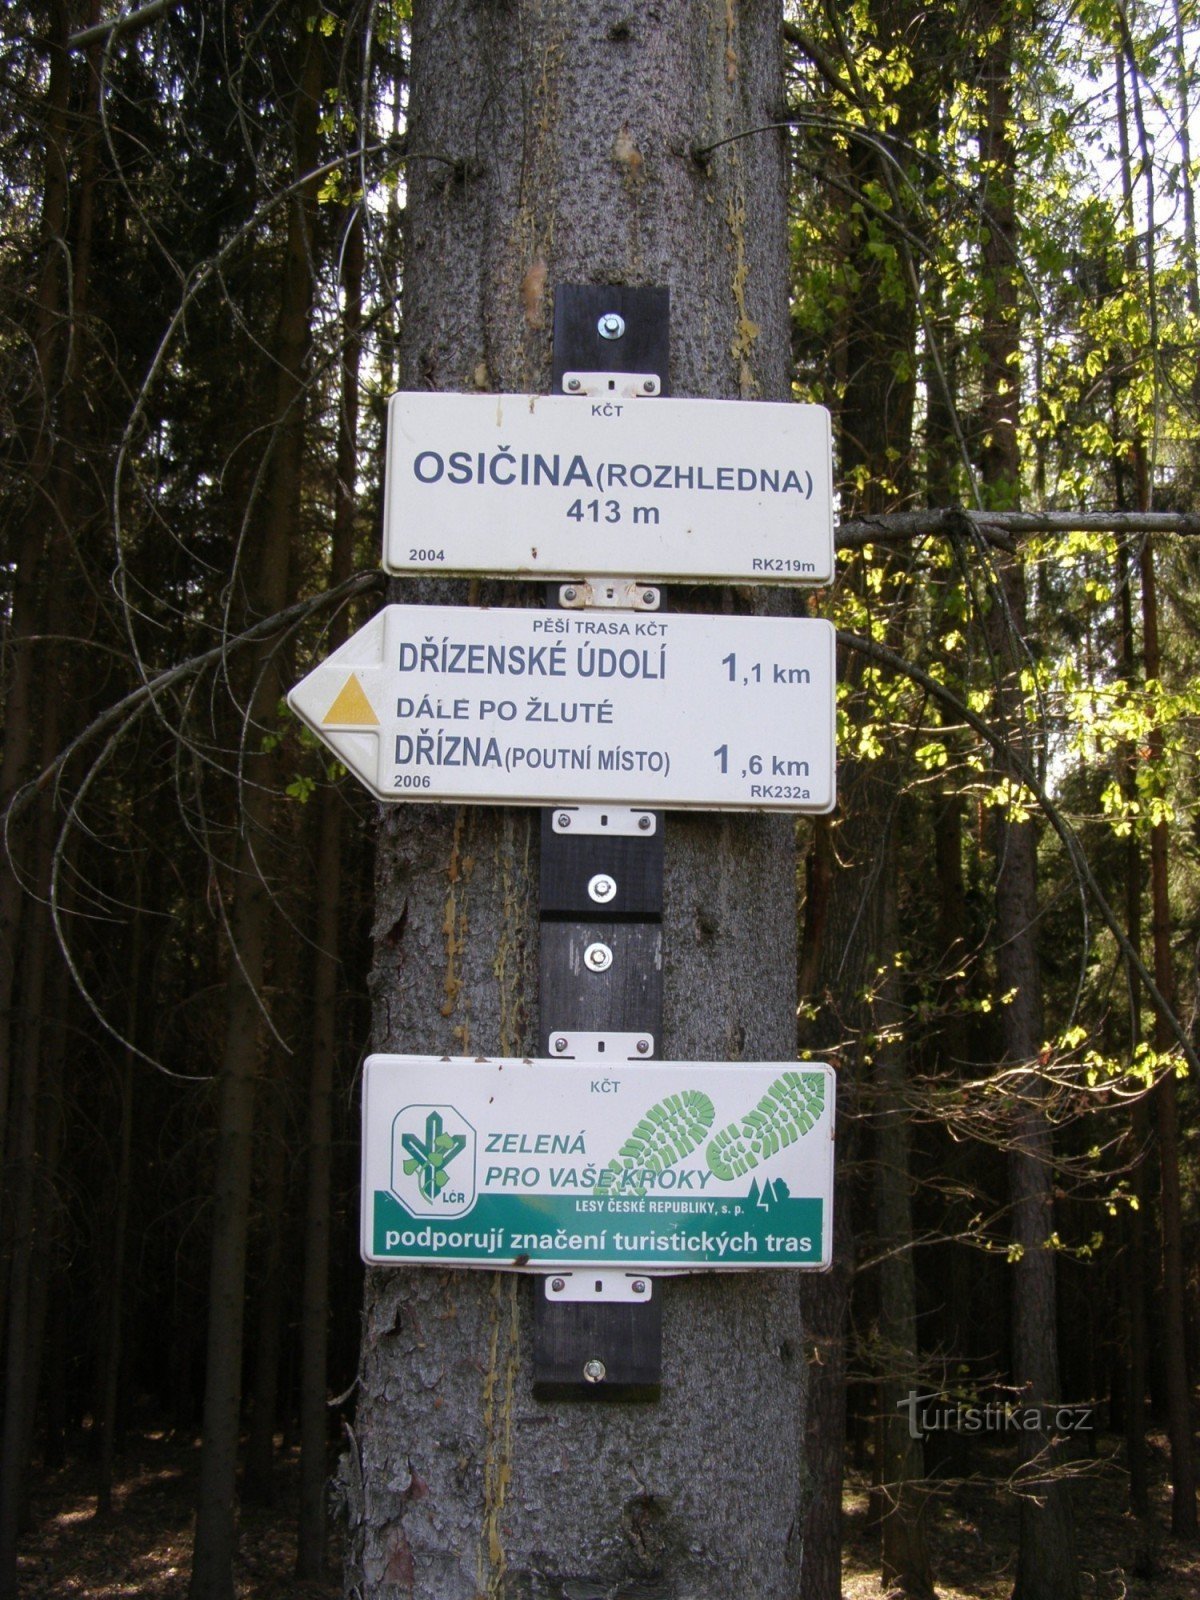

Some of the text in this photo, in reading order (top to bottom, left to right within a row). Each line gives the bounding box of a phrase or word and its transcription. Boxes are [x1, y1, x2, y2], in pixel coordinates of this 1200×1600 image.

[591, 403, 623, 417] KČT
[413, 445, 813, 499] OSIČINA (ROZHLEDNA)
[567, 501, 659, 524] 413 m
[409, 549, 445, 561] 2004
[752, 559, 815, 572] RK219m
[533, 618, 668, 637] PĚŠÍ TRASA KČT
[399, 637, 810, 686] DŘÍZENSKÉ ÚDOLÍ 1,1 km
[397, 697, 614, 724] DÁLE PO ŽLUTÉ
[395, 728, 501, 766] DŘÍZNA
[505, 744, 592, 772] (POUTNÍ
[598, 746, 670, 777] MÍSTO)
[772, 755, 809, 776] km
[394, 775, 431, 788] 2006
[751, 785, 810, 799] RK232a
[591, 1080, 620, 1093] KČT
[485, 1130, 586, 1154] ZELENÁ
[485, 1164, 712, 1189] PRO VAŠE KROKY
[576, 1200, 604, 1212] LESY
[608, 1196, 645, 1213] ČESKÉ
[649, 1201, 718, 1215] REPUBLIKY,
[385, 1227, 812, 1256] podporují značení turistických tras
